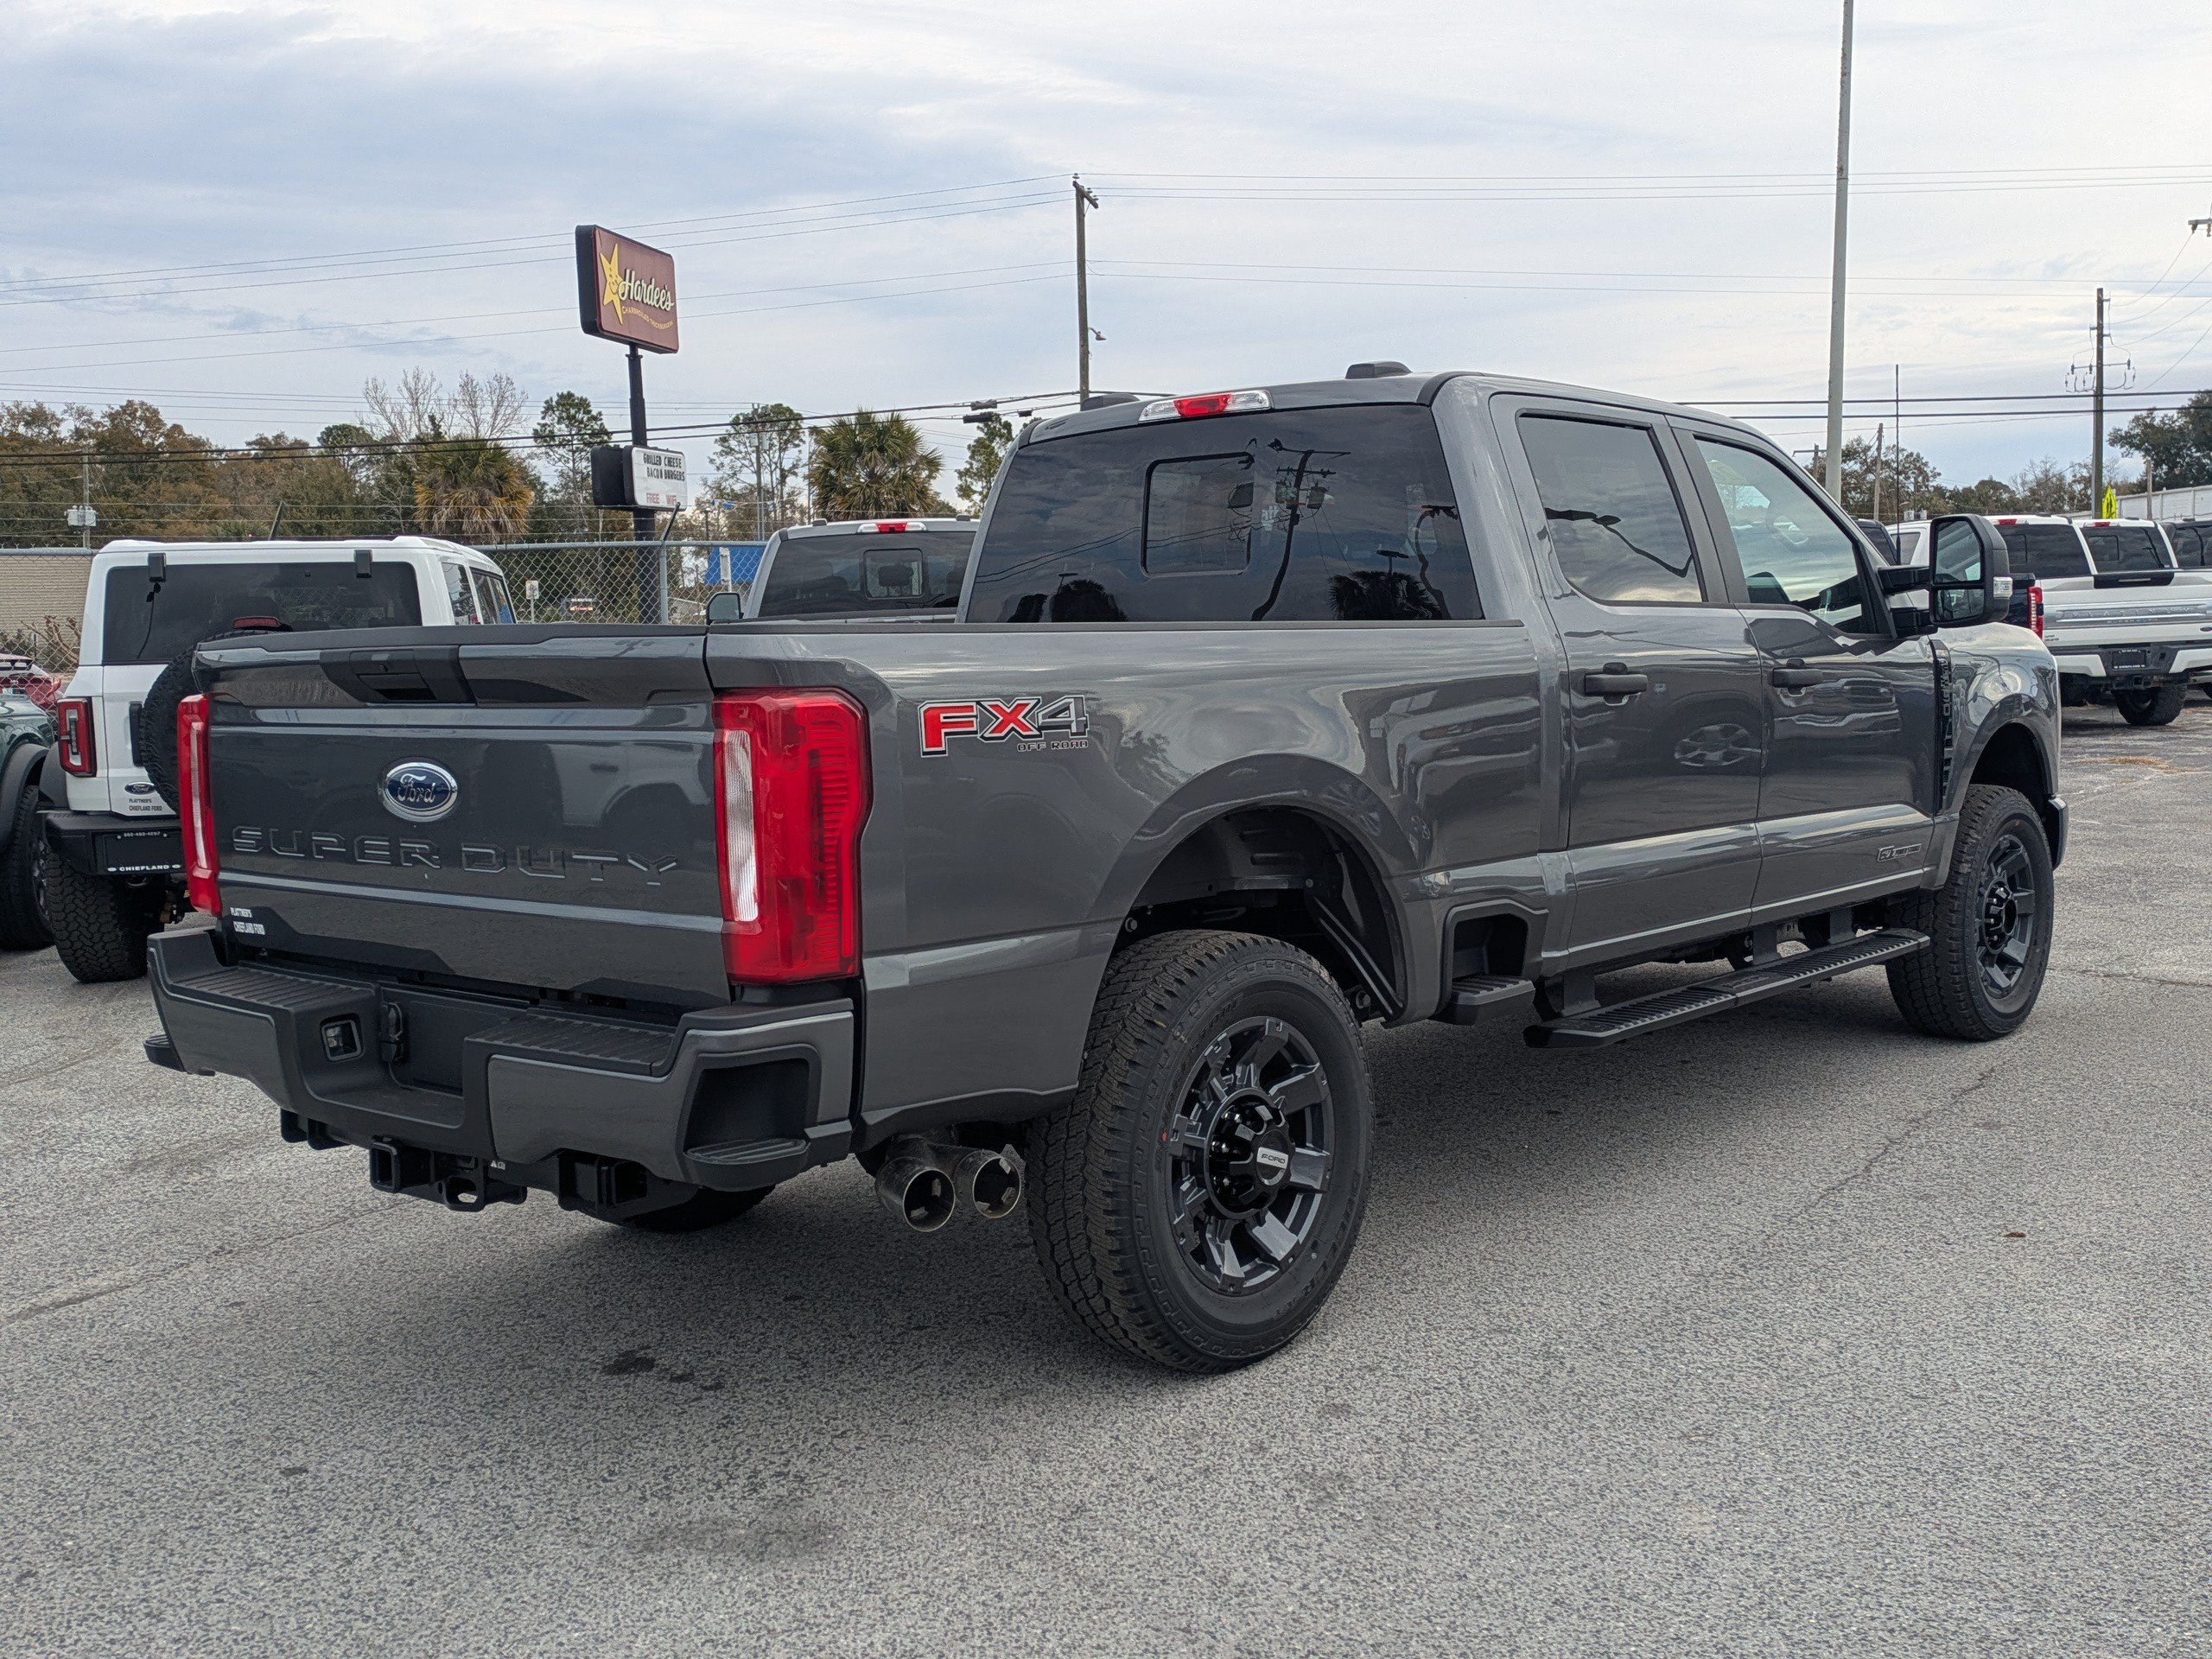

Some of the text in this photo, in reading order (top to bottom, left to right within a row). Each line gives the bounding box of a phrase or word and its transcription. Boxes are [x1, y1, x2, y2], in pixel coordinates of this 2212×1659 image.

[618, 268, 675, 312] Hardee's
[622, 306, 649, 322] CHARBROILED
[644, 453, 682, 468] GRILLED CHEESE
[646, 466, 685, 481] BACON BURGERS
[645, 493, 660, 505] FREE
[917, 695, 1090, 758] FX4
[1016, 739, 1089, 753] OFF ROAD
[397, 773, 436, 804] Ford
[231, 824, 679, 887] SUPER DUTY
[1261, 1153, 1286, 1165] FORD
